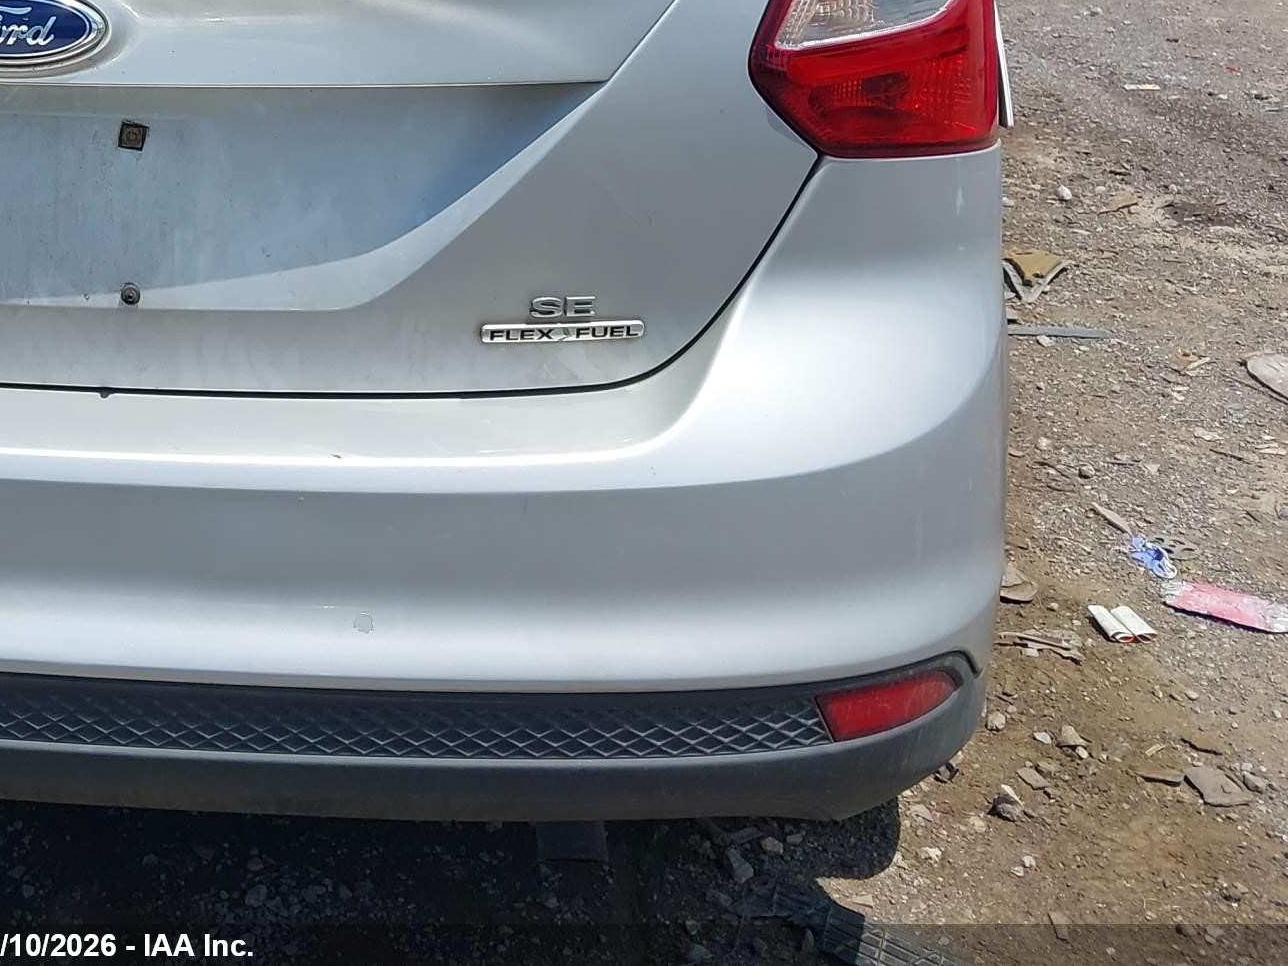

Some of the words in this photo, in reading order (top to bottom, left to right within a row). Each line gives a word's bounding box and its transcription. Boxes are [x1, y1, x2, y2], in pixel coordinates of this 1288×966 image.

[530, 296, 596, 318] SE
[489, 328, 555, 341] FLEX
[575, 325, 640, 339] FUEL
